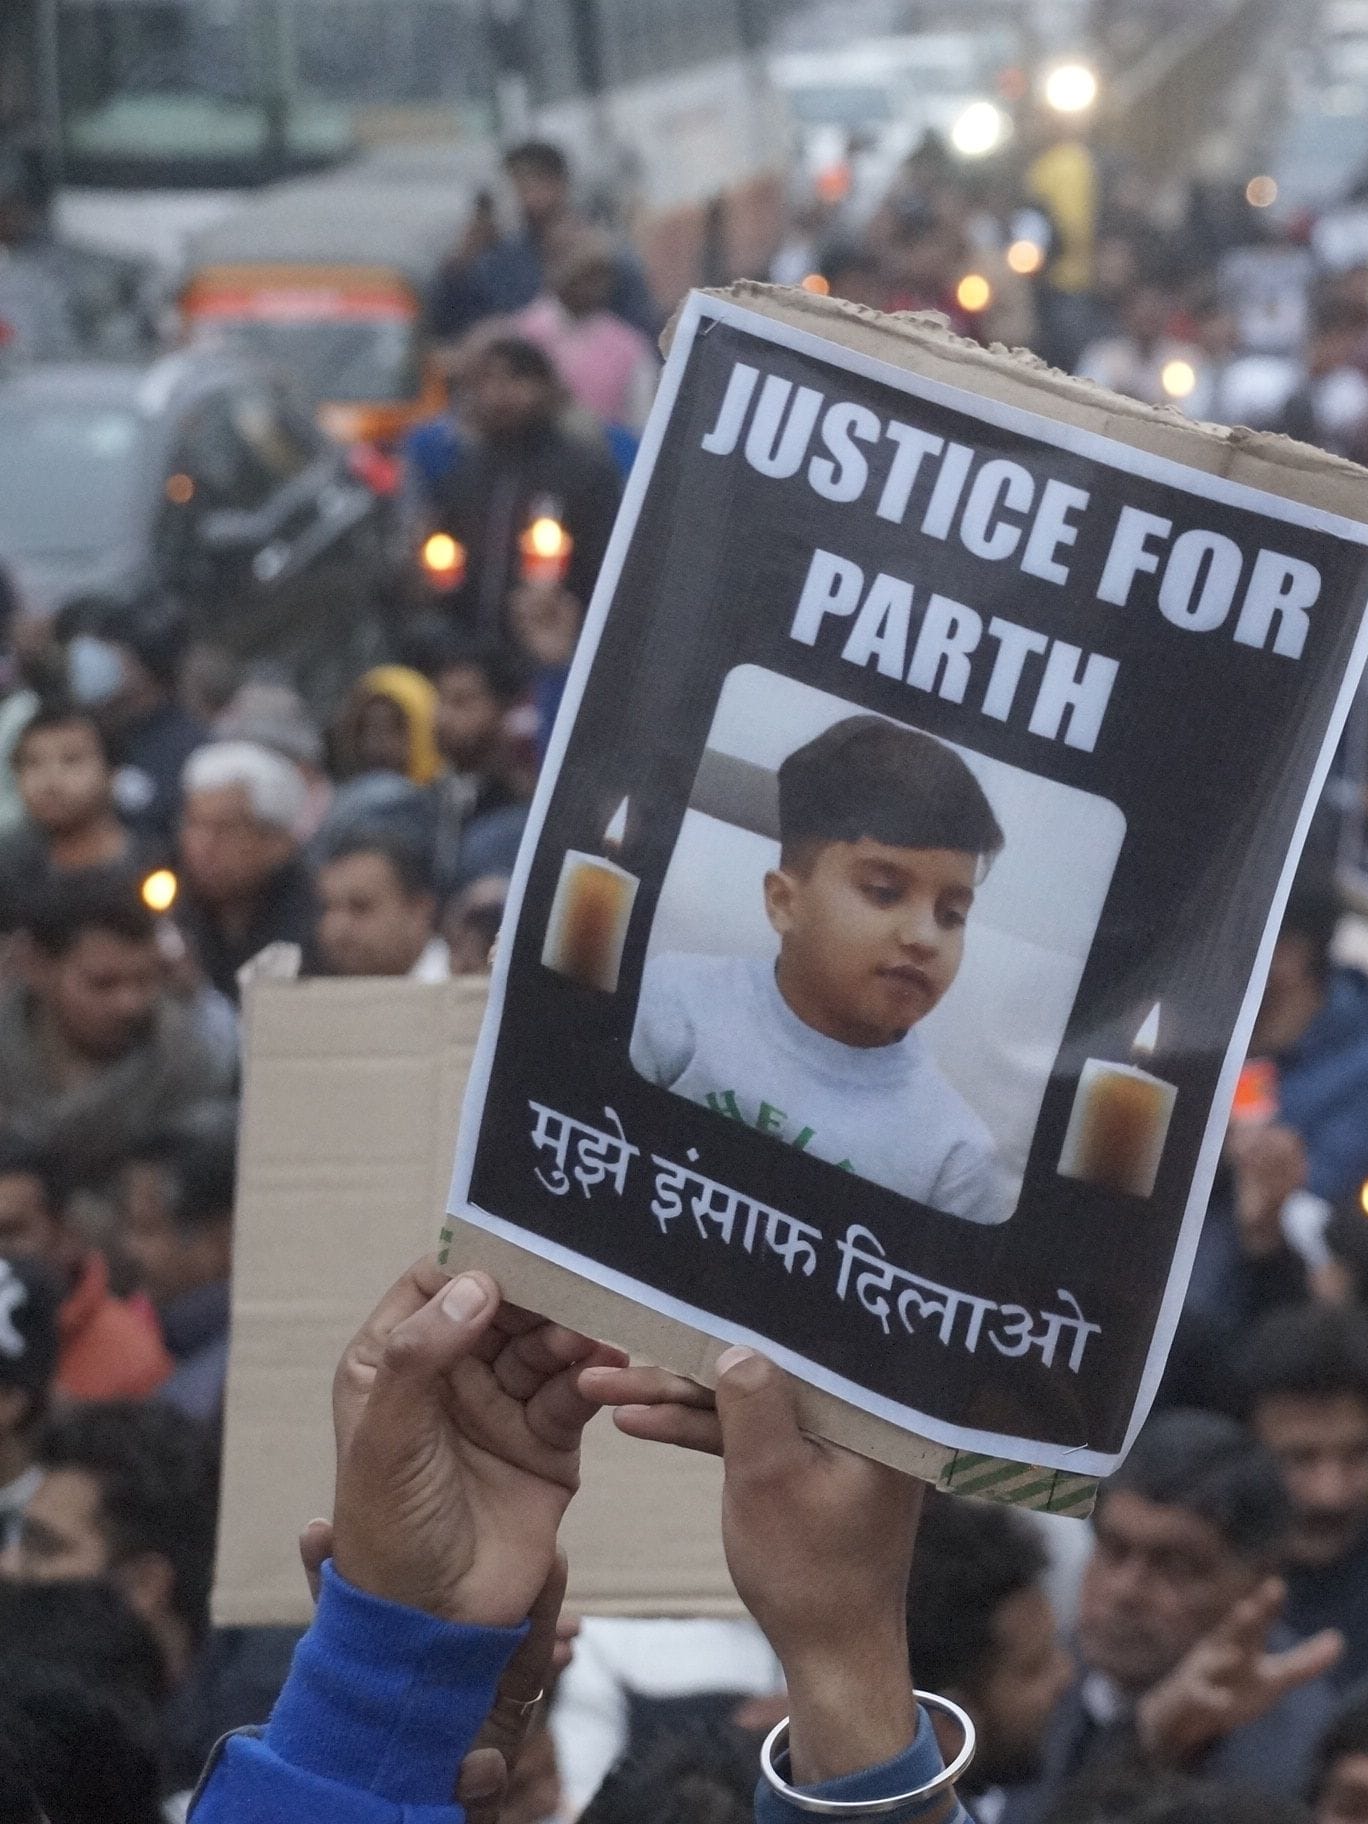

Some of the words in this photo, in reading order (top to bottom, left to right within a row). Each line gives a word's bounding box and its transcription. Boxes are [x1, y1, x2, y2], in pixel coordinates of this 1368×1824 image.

[700, 361, 1091, 587] JUSTICE
[1095, 504, 1322, 661] FOR
[789, 547, 1121, 753] PARTH
[527, 1099, 641, 1200] मुझे
[650, 1146, 823, 1278] इंसाफ
[836, 1223, 1103, 1375] दिलाओ
